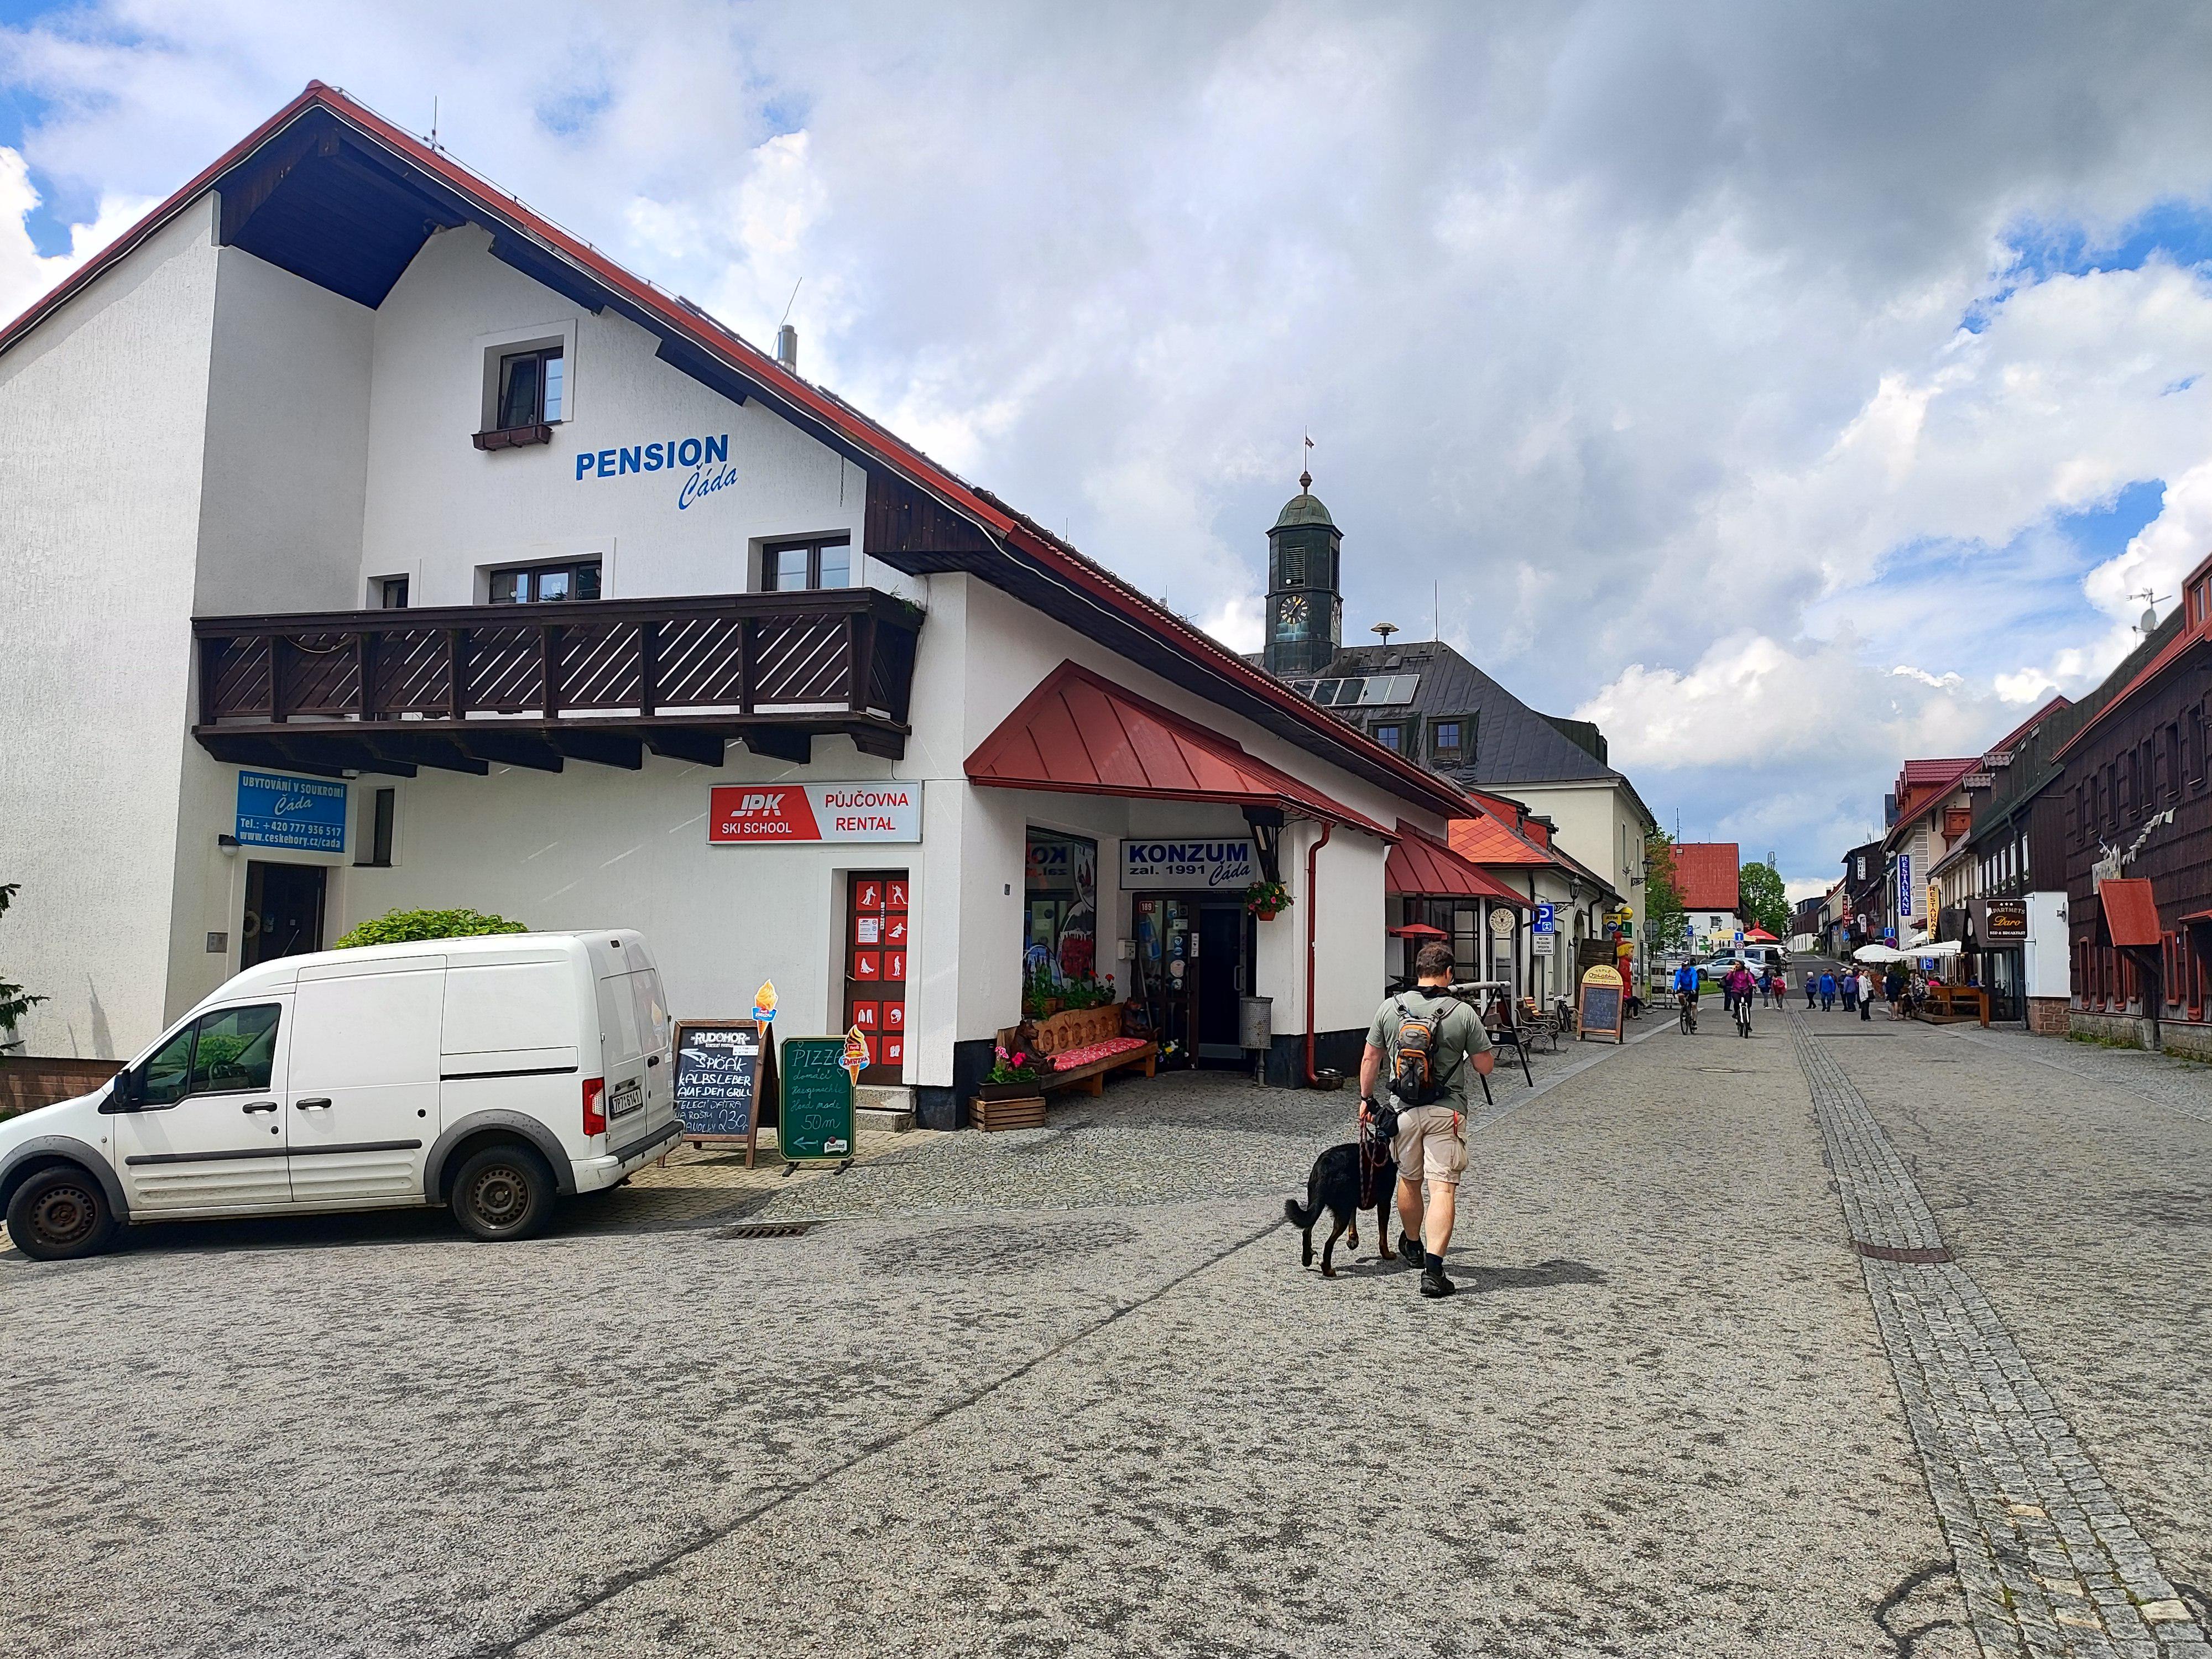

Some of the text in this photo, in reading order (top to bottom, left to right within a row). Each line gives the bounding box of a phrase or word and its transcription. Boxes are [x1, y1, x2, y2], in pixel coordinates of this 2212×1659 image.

[576, 434, 728, 481] PENSION
[678, 462, 738, 510] Čáda
[243, 776, 344, 798] UBYTOVÁNÍ V SOUKROMÍ
[274, 793, 314, 816] Čáda
[731, 793, 786, 817] JPK
[825, 790, 909, 808] PŮJČOVNA
[240, 818, 341, 837] Tel.: +420 777 936 517
[722, 822, 792, 834] SKI SCHOOL
[836, 816, 896, 831] RENTAL
[240, 831, 341, 848] www.ceskehory.cz/cada
[1129, 843, 1248, 863] KONZUM
[1129, 865, 1205, 875] zal. 1991
[1208, 859, 1251, 886] Čáda
[1901, 856, 1910, 915] RESTAURANT
[1993, 916, 2023, 926] Daro
[726, 1087, 752, 1098] GRILL
[790, 1099, 841, 1112] Hand made
